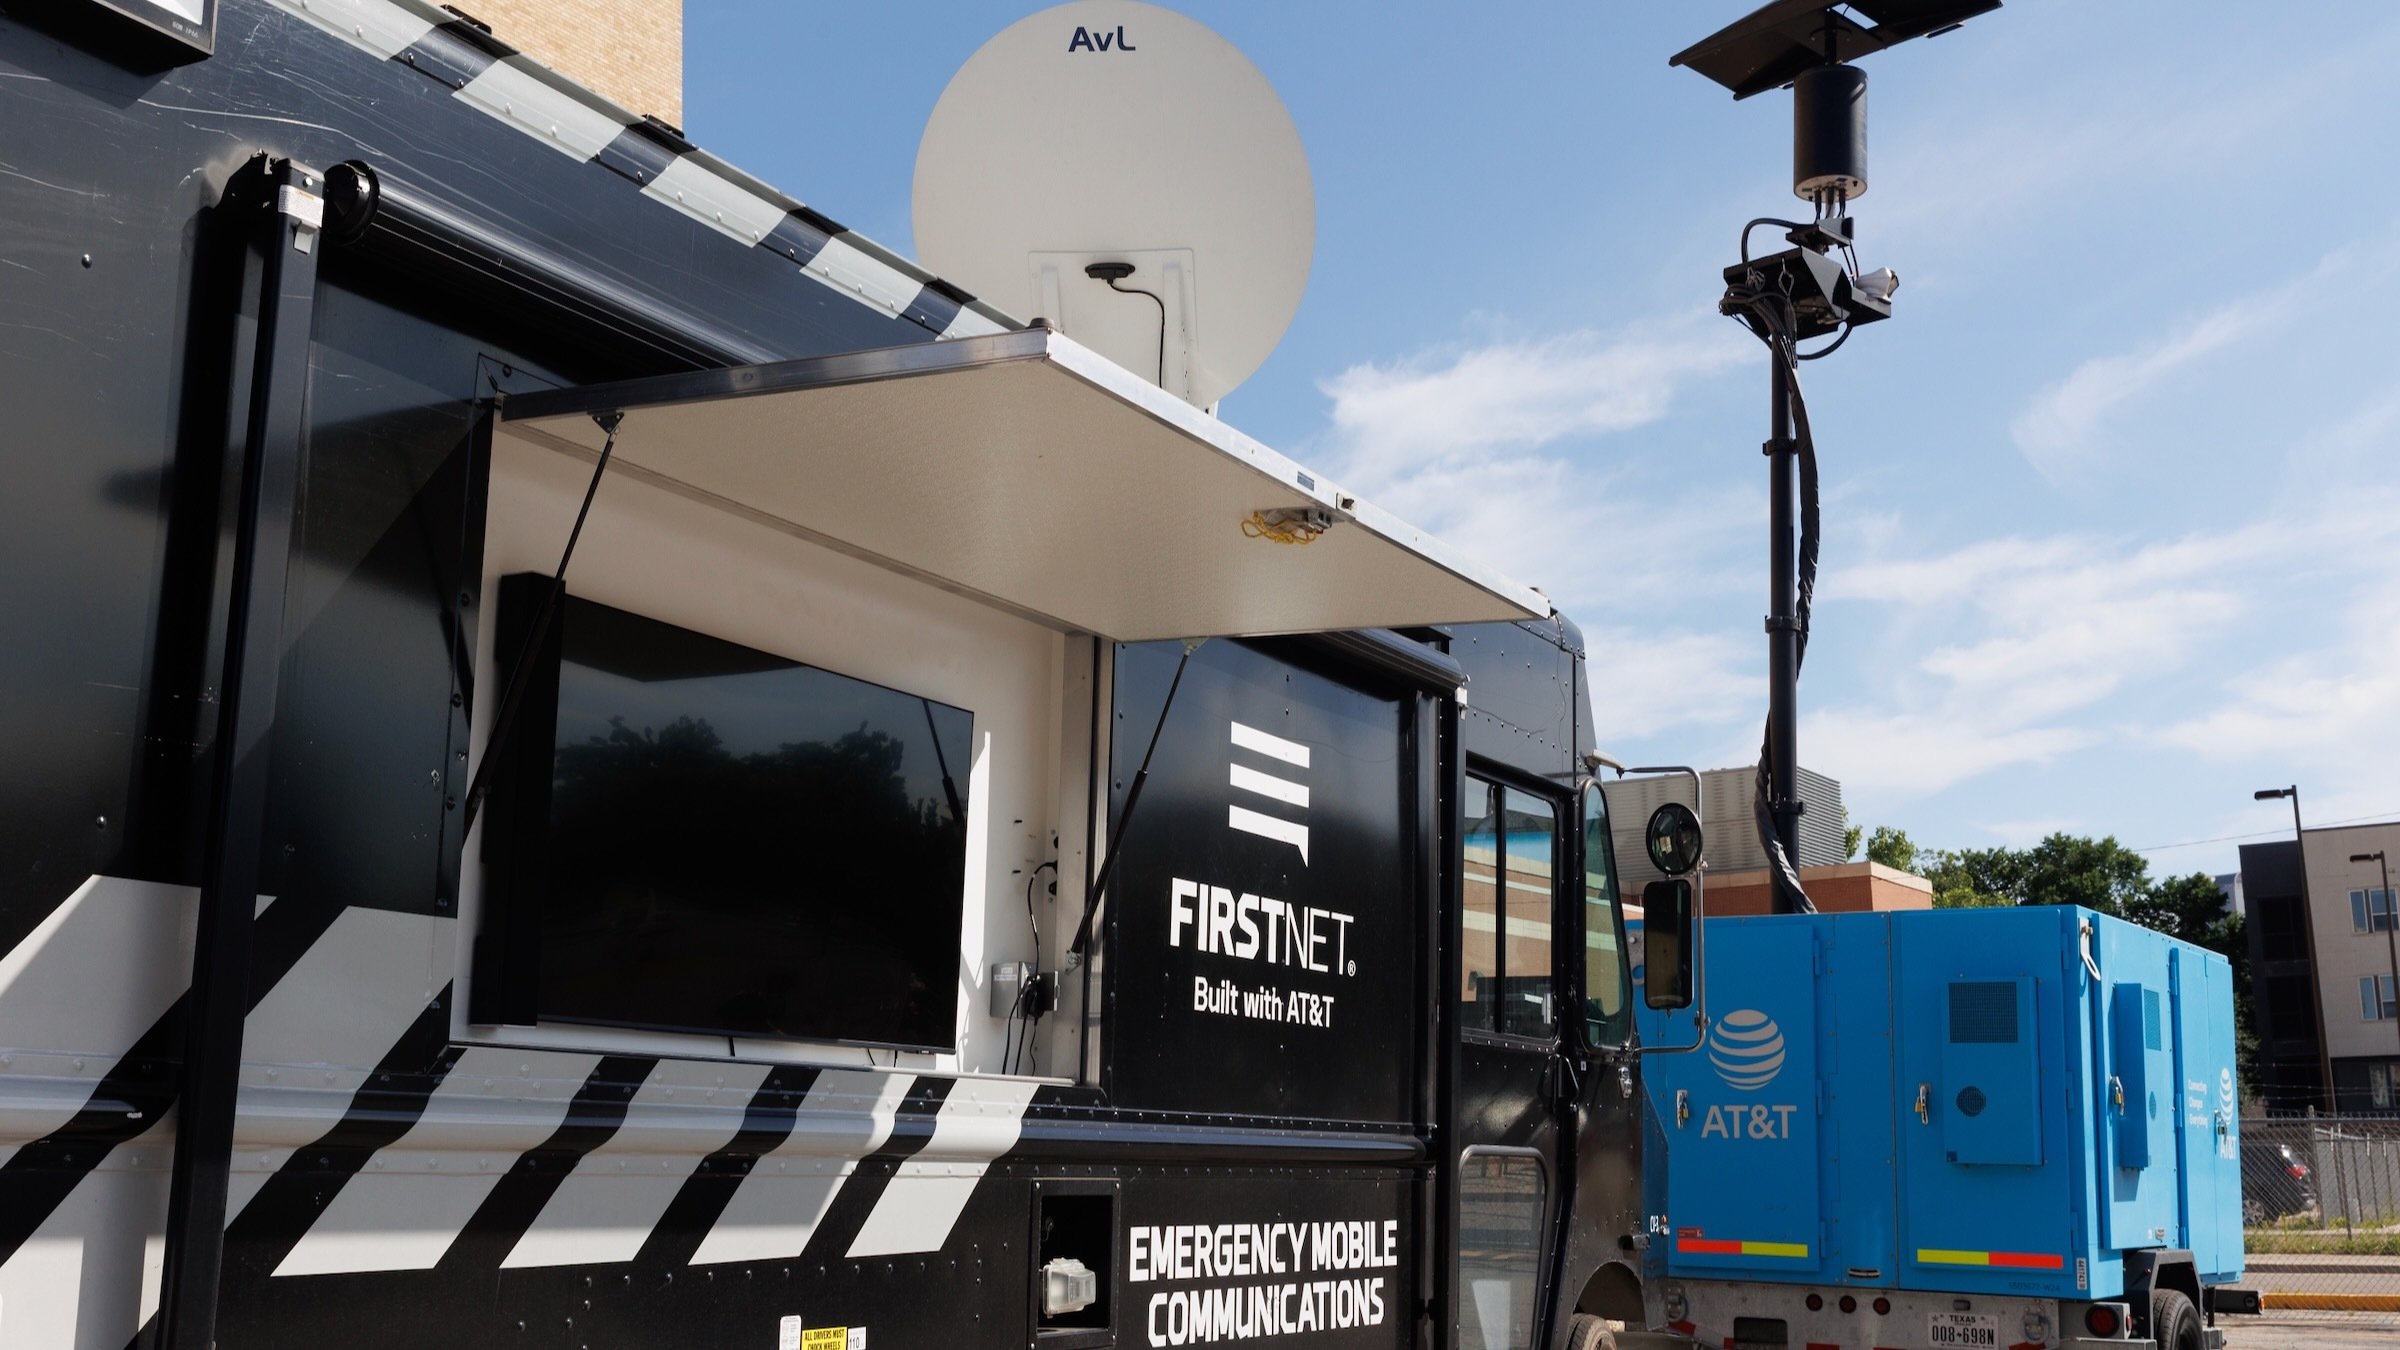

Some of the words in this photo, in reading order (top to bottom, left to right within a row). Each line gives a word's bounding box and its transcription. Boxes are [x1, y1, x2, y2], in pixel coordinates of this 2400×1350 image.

[1068, 26, 1136, 52] AvL
[1194, 976, 1239, 1016] Built
[1243, 986, 1283, 1021] with
[1286, 991, 1335, 1028] AT&T
[1701, 1104, 1797, 1139] AT&T
[1129, 1222, 1308, 1282] EMERGENCY
[1312, 1220, 1398, 1271] MOBILE
[1148, 1277, 1385, 1348] COMMUNICATIONS
[1949, 1314, 1976, 1323] TEXAS
[804, 1331, 813, 1341] ALL
[814, 1330, 832, 1339] DRIVERS
[833, 1328, 845, 1338] MUST
